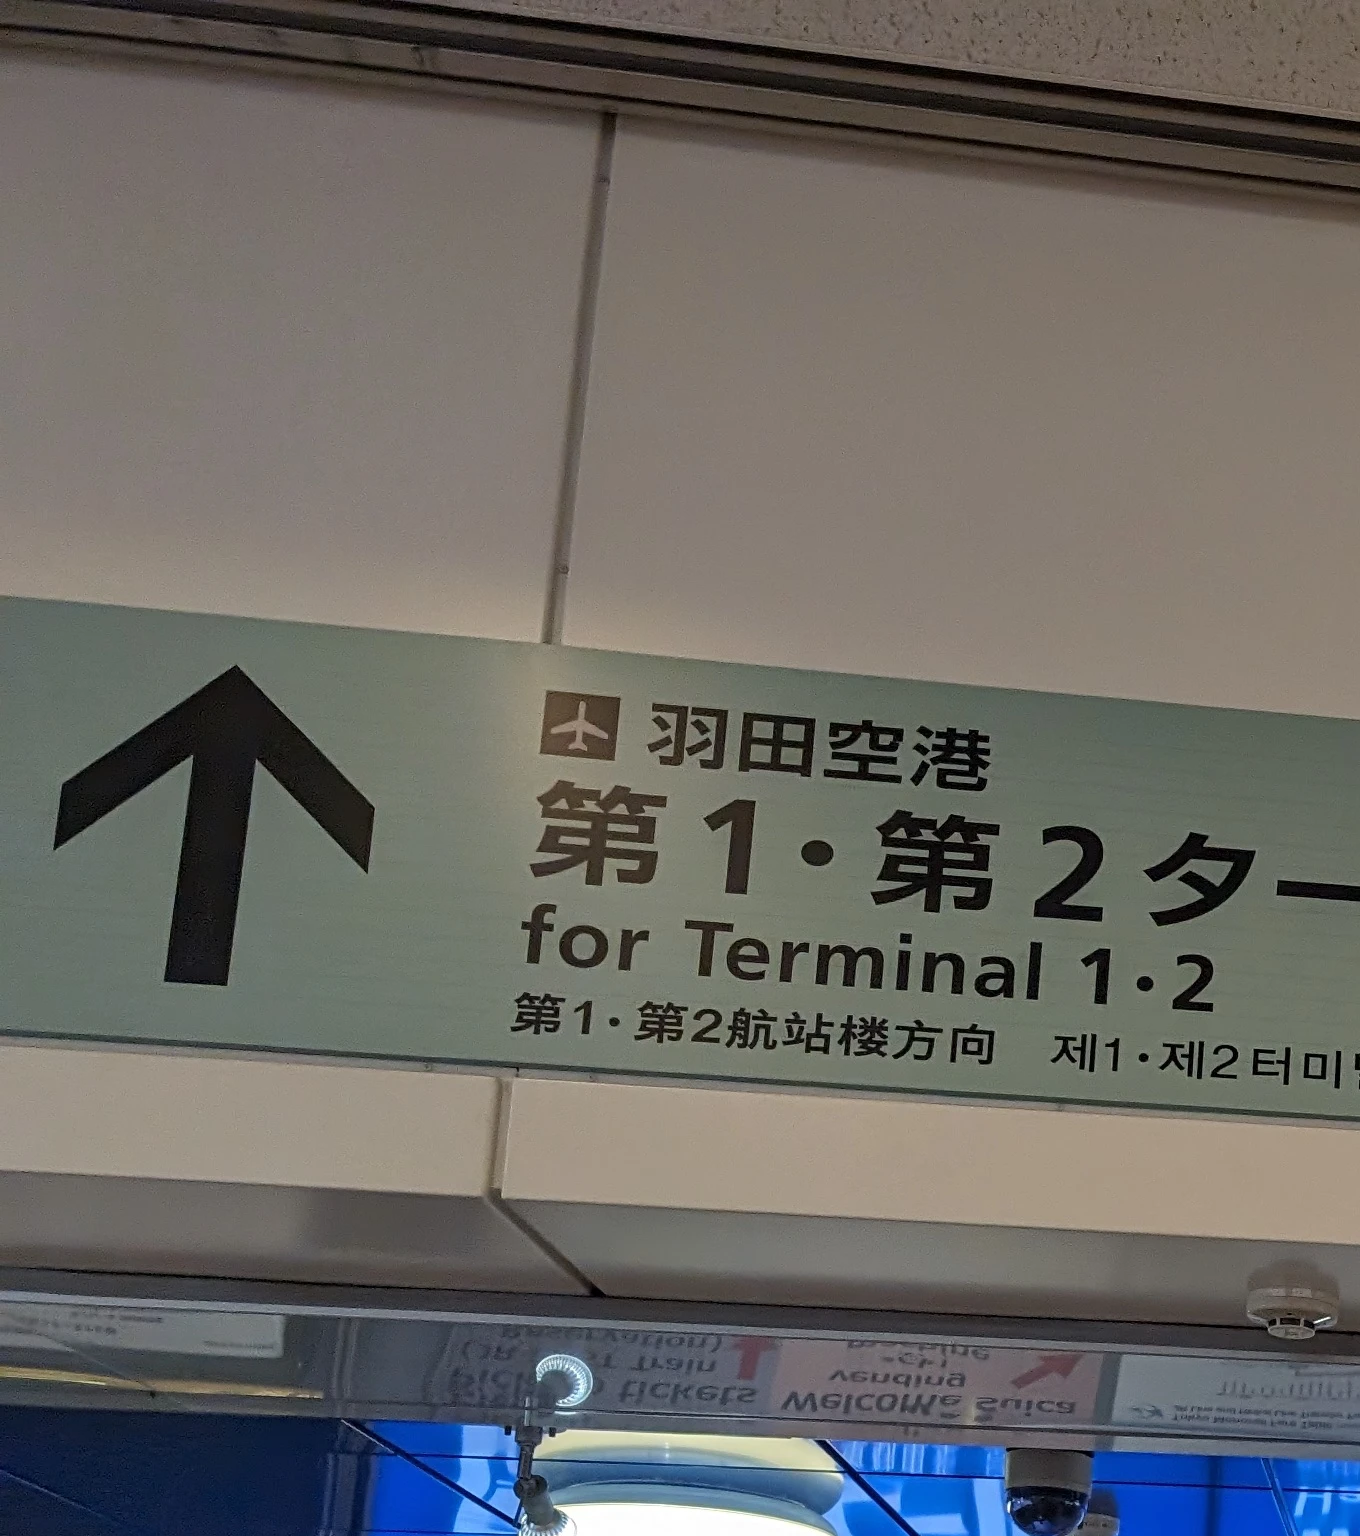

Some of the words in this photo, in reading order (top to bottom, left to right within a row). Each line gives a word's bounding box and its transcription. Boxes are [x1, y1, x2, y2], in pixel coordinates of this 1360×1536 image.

[648, 703, 991, 791] 羽田空港
[521, 904, 649, 971] for
[685, 920, 1042, 1000] Terminal
